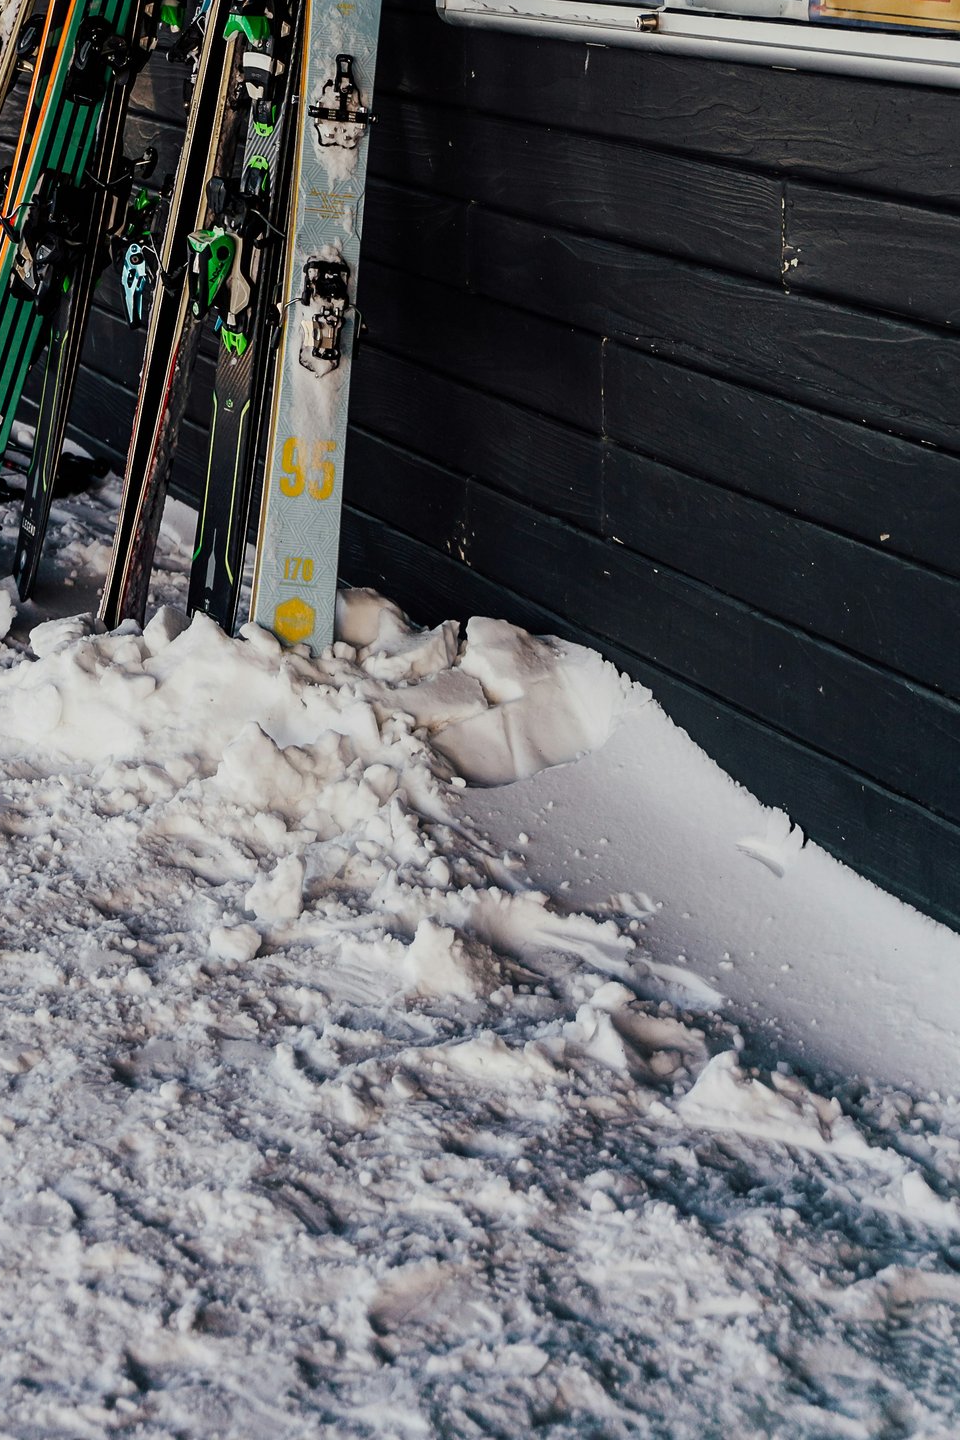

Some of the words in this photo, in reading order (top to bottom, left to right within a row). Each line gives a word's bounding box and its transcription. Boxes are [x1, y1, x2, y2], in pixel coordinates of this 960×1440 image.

[279, 436, 338, 501] 95
[21, 516, 36, 537] LEGEND
[282, 556, 315, 582] 170
